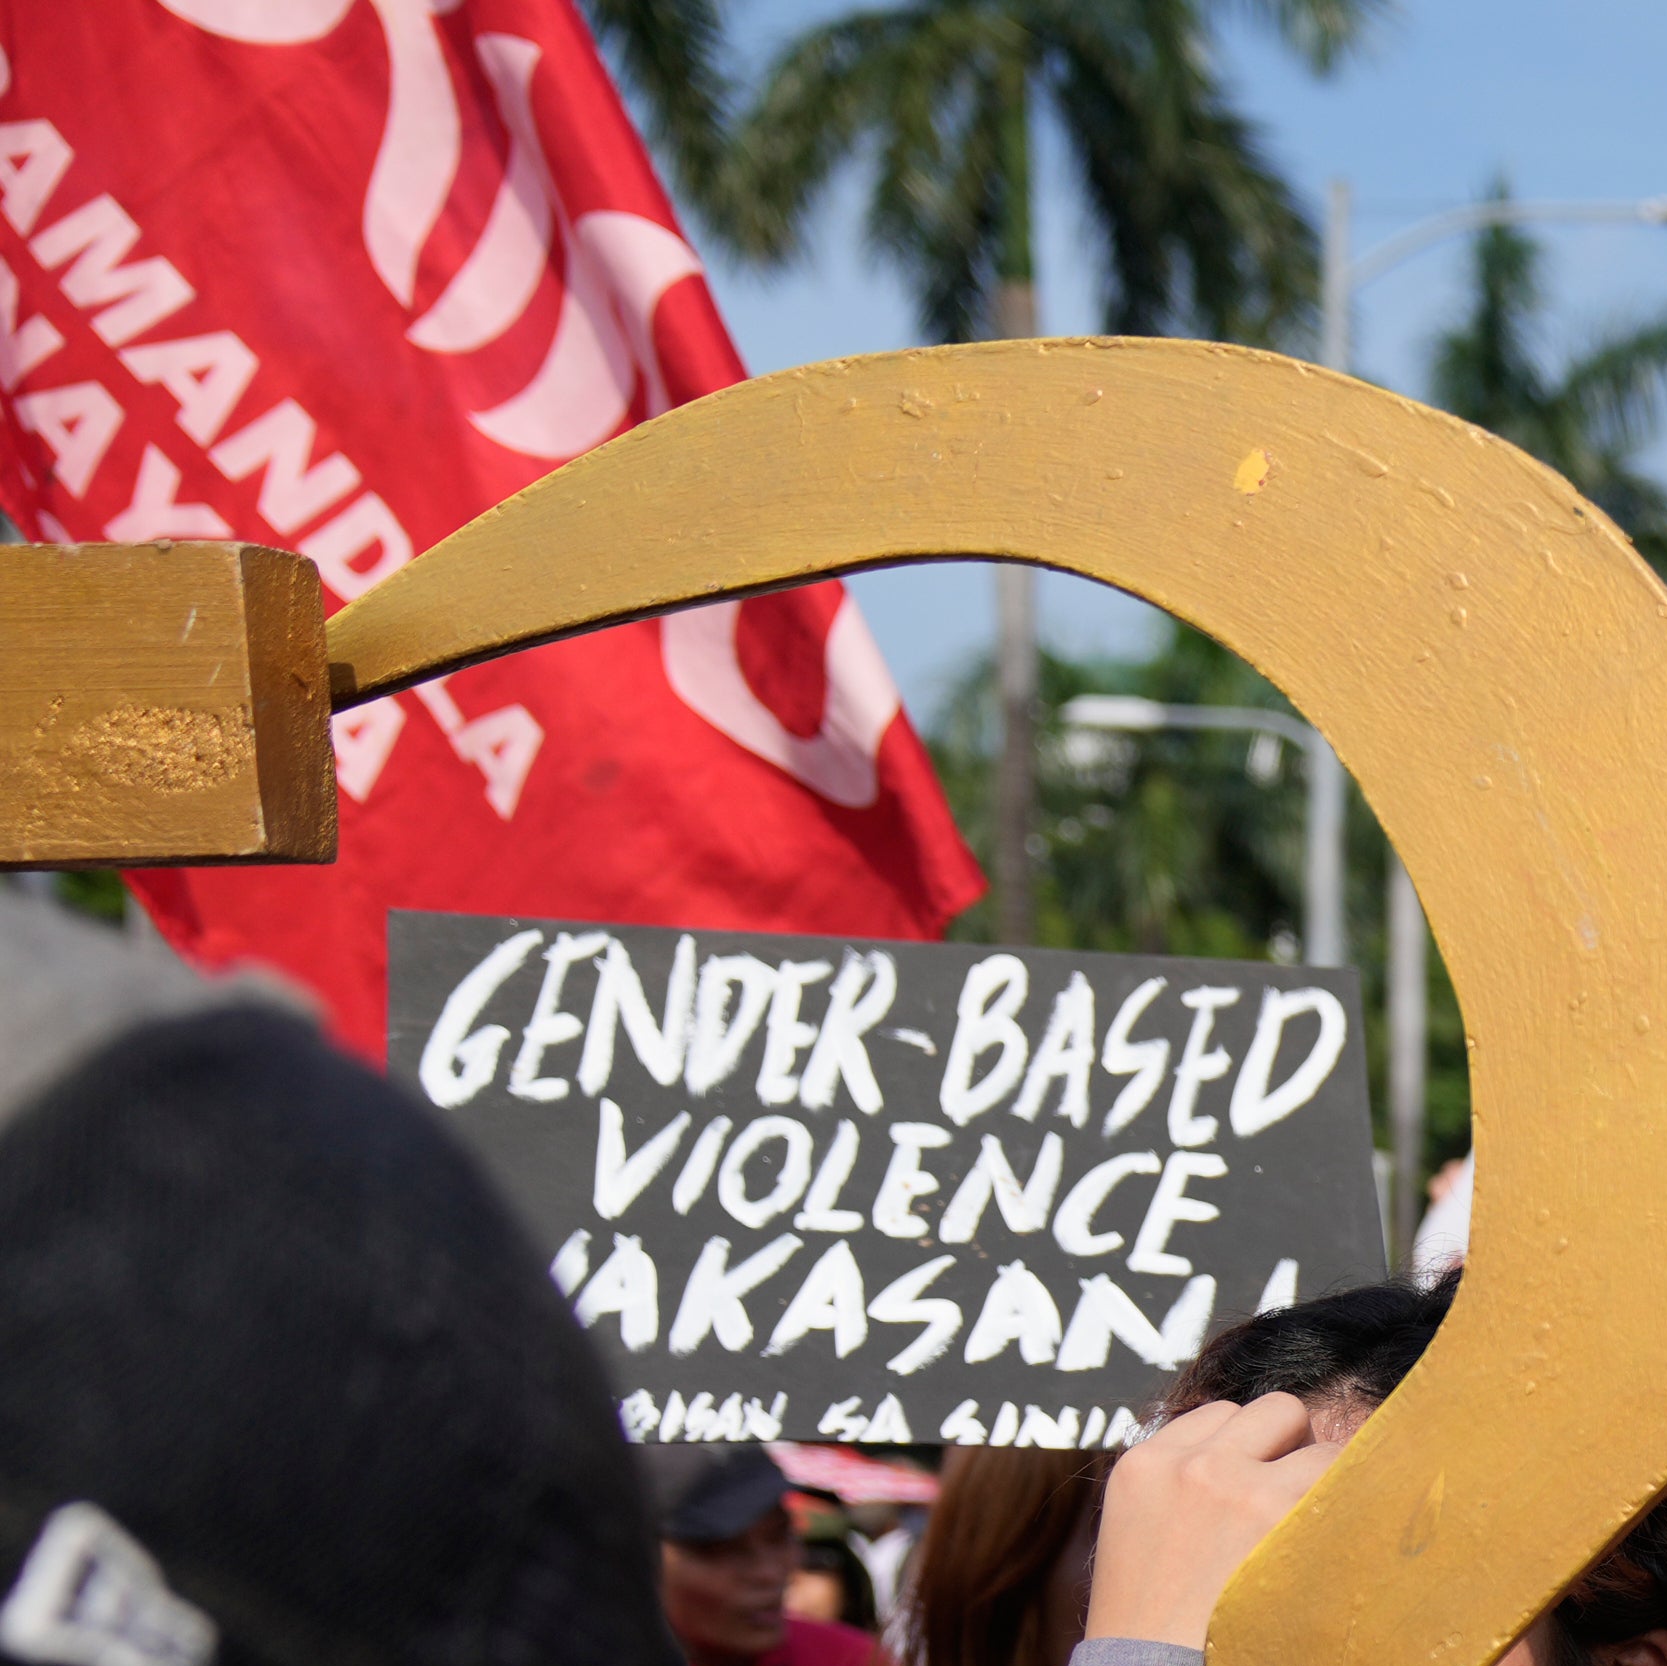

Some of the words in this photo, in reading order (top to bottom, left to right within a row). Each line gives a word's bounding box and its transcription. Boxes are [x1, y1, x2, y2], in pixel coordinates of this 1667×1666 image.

[419, 928, 1346, 1148] GENDER-BASED
[593, 1097, 1229, 1276] VIOLENCE
[550, 1229, 1299, 1376] AKASAN
